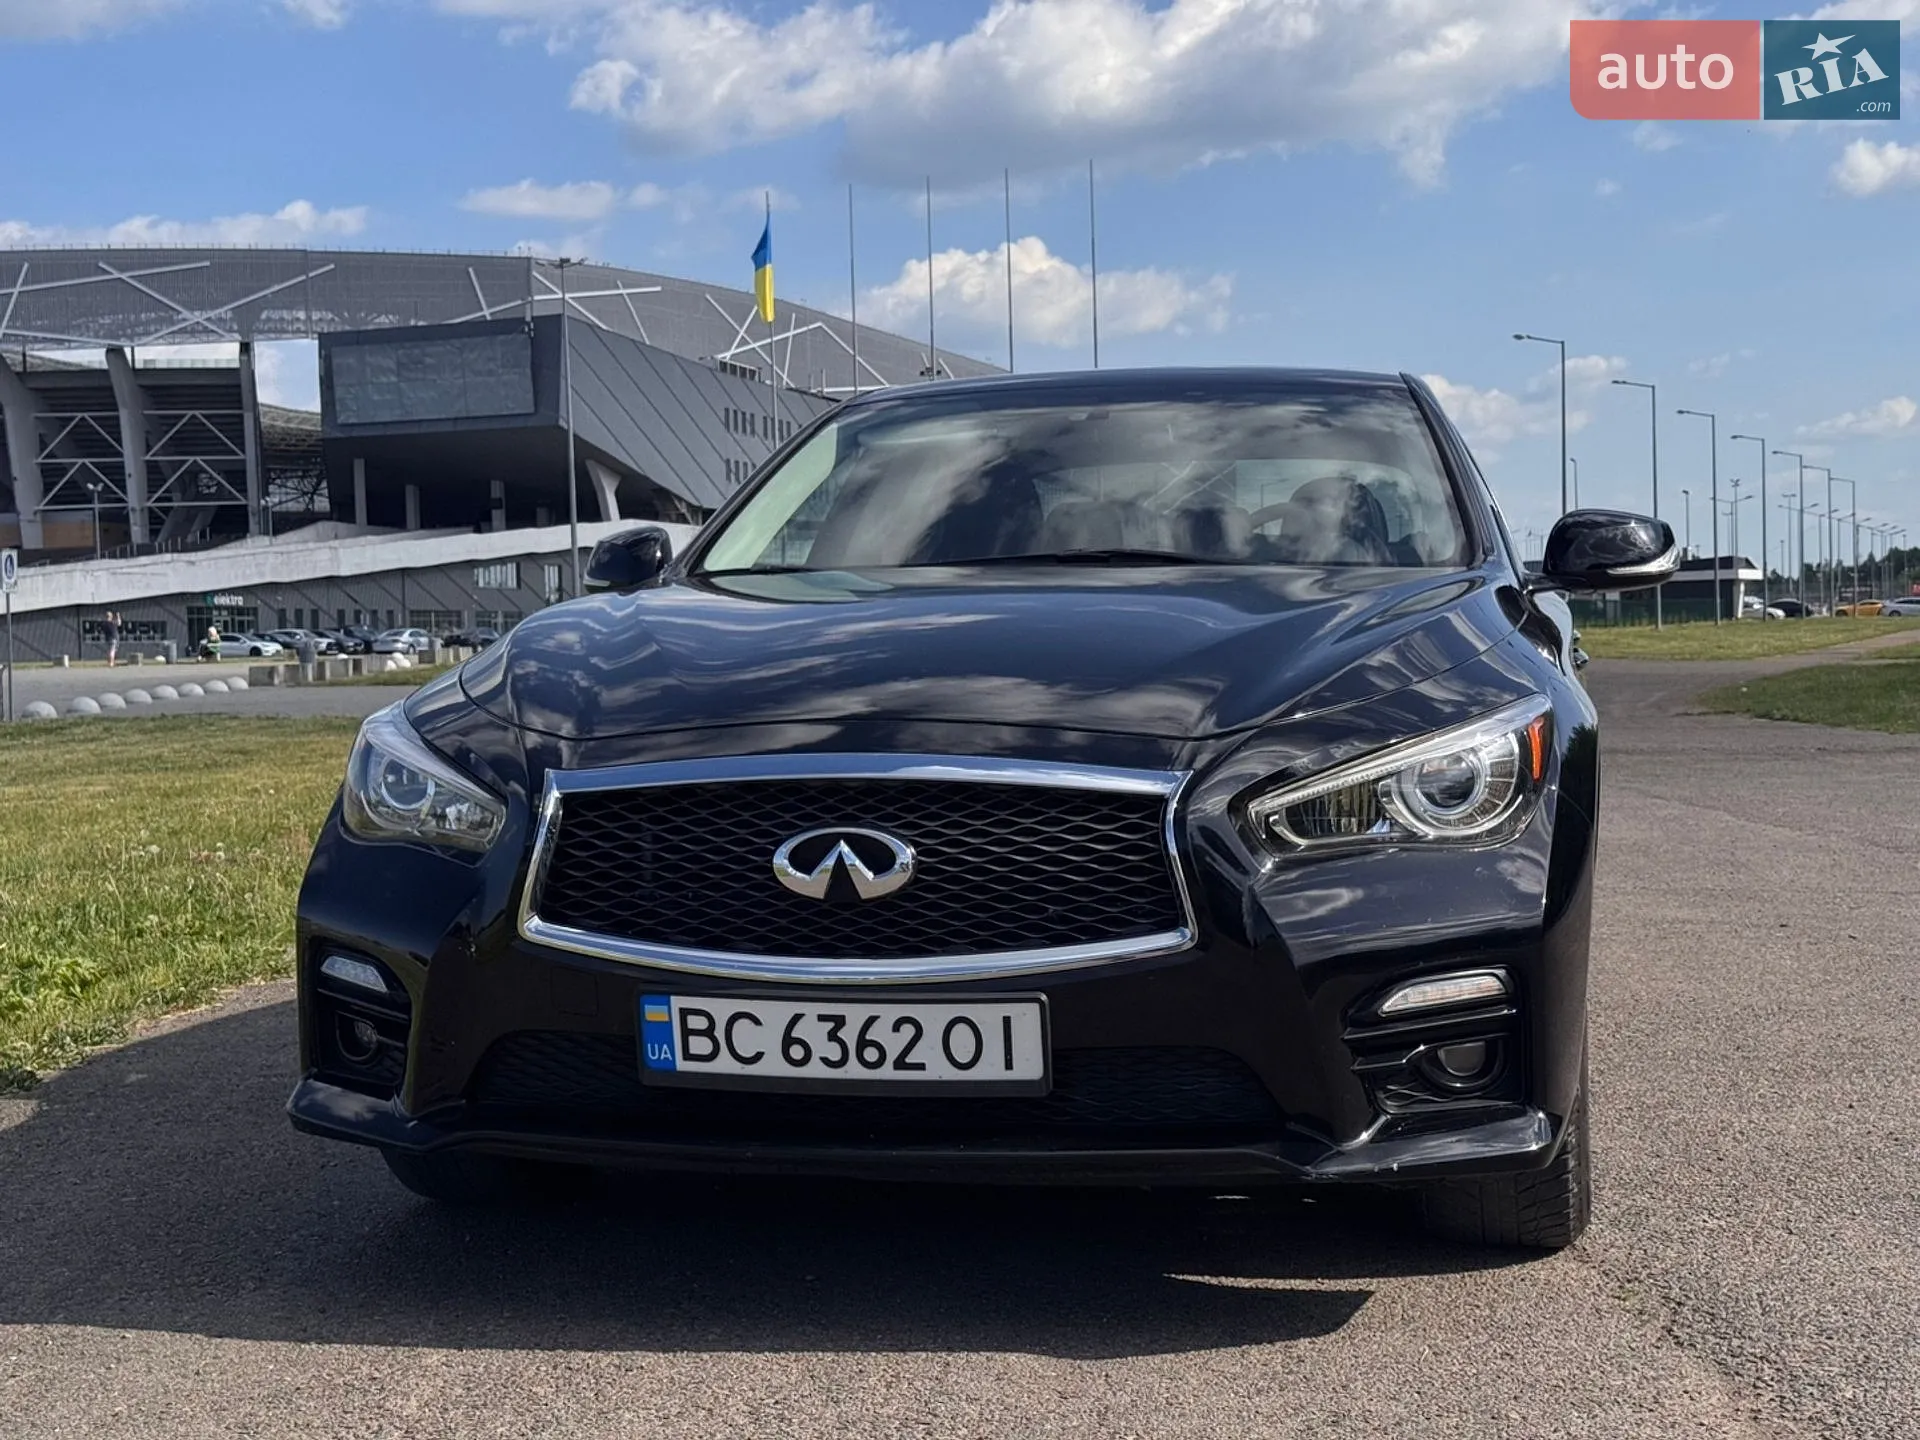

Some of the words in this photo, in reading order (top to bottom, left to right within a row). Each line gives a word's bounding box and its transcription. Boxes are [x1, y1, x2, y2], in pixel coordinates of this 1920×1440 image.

[648, 1043, 672, 1060] UA
[678, 1008, 765, 1065] BC
[781, 1013, 927, 1071] 6362
